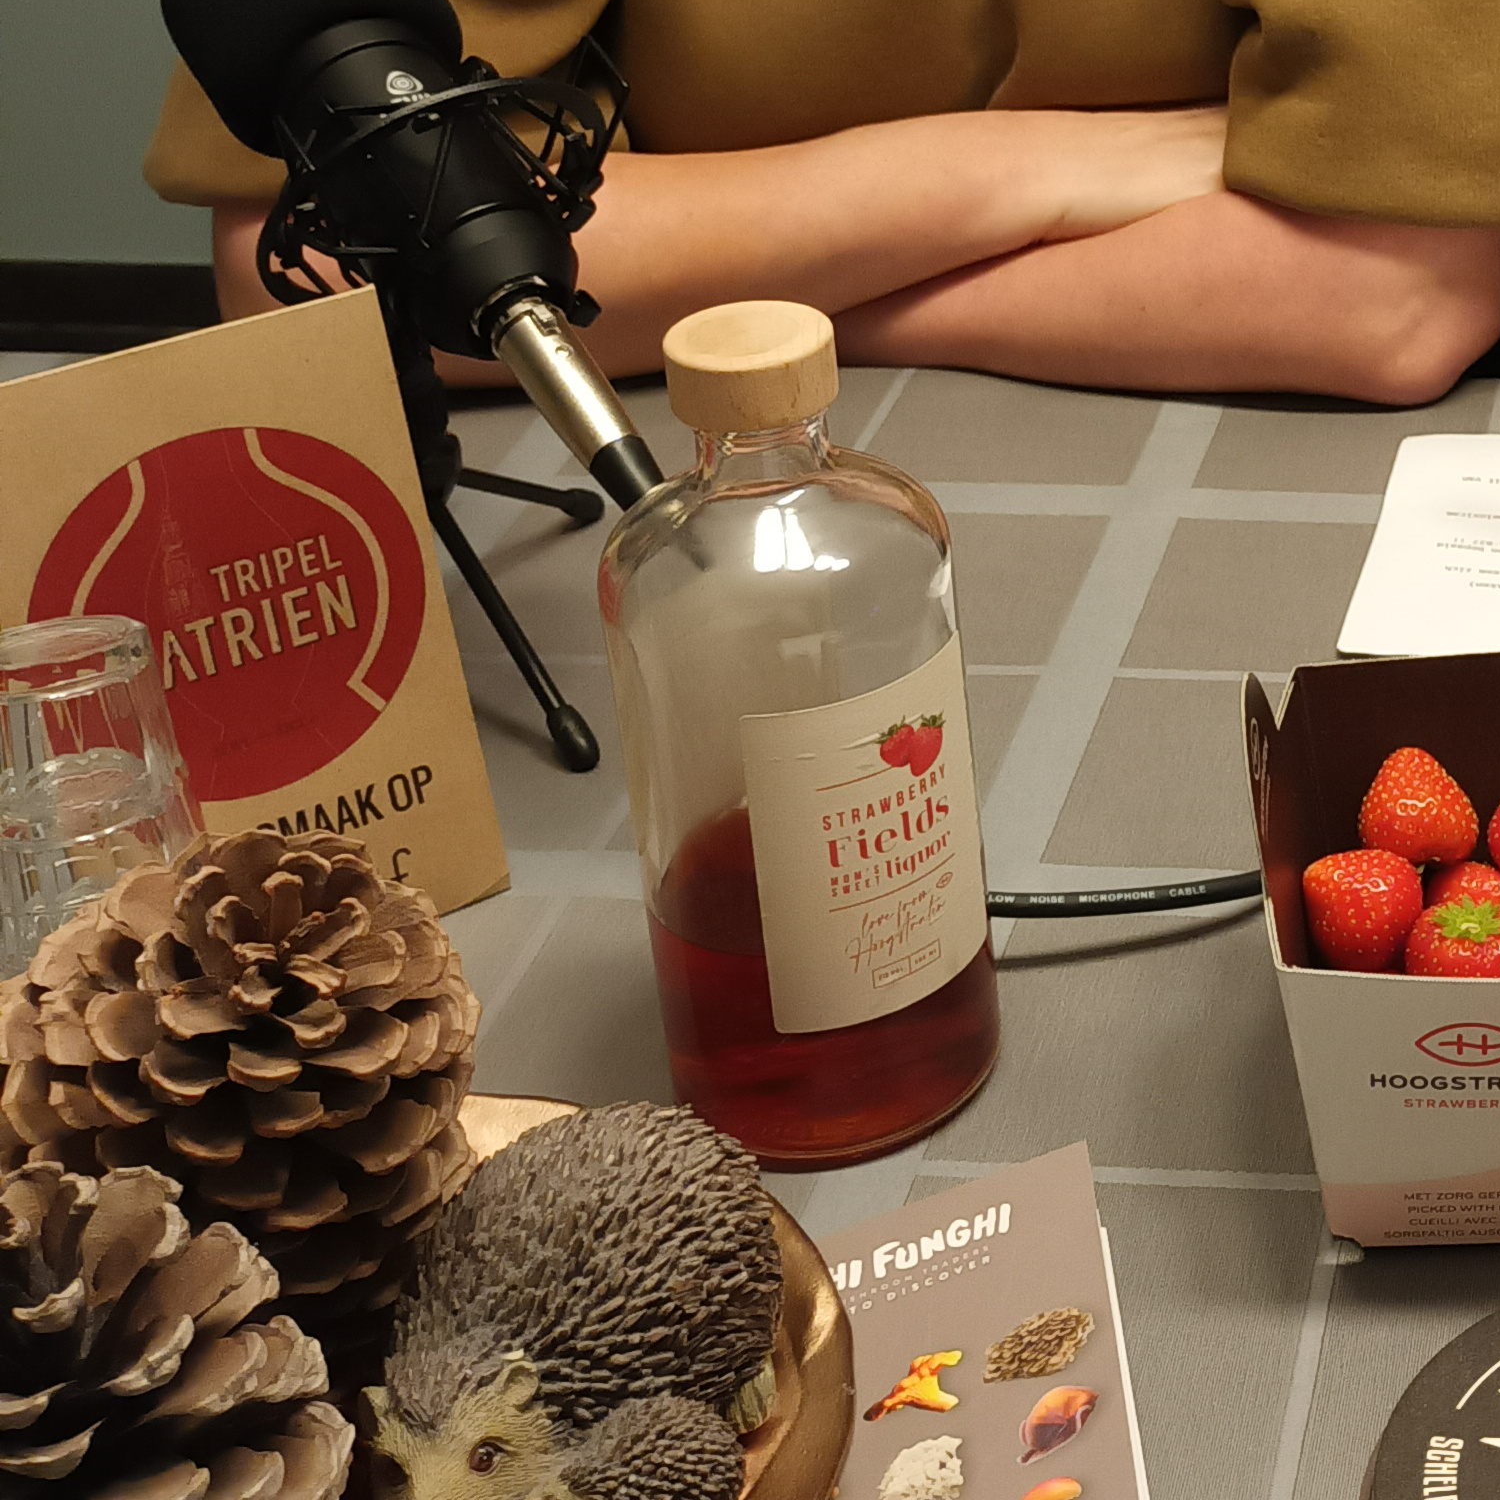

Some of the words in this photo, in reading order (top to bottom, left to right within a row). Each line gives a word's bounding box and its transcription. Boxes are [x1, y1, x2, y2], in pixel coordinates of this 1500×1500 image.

[209, 534, 343, 602] TRIPEL
[163, 574, 357, 690] ATRIEN
[257, 782, 385, 837] MAAK
[387, 765, 433, 812] OP
[822, 763, 945, 832] STRAWBERRY
[827, 795, 949, 869] Fields
[885, 830, 951, 879] liquor
[831, 875, 880, 898] SWEET
[988, 894, 1015, 904] LOW
[1029, 895, 1065, 905] NOISE
[1079, 890, 1156, 904] MICROPHONE
[1168, 884, 1207, 898] CABLE
[1403, 1191, 1433, 1201] MET
[1436, 1190, 1475, 1200] ZORG
[1407, 1204, 1458, 1214] PICKED
[1459, 1203, 1495, 1213] WITH
[1463, 1216, 1498, 1225] AVEC
[829, 1259, 863, 1291] HI
[843, 1274, 913, 1306] SHROOM
[922, 1245, 990, 1276] TRADERS
[849, 1300, 873, 1316] TO
[886, 1255, 991, 1302] DISCOVER
[1422, 1435, 1464, 1500] SCHEL
